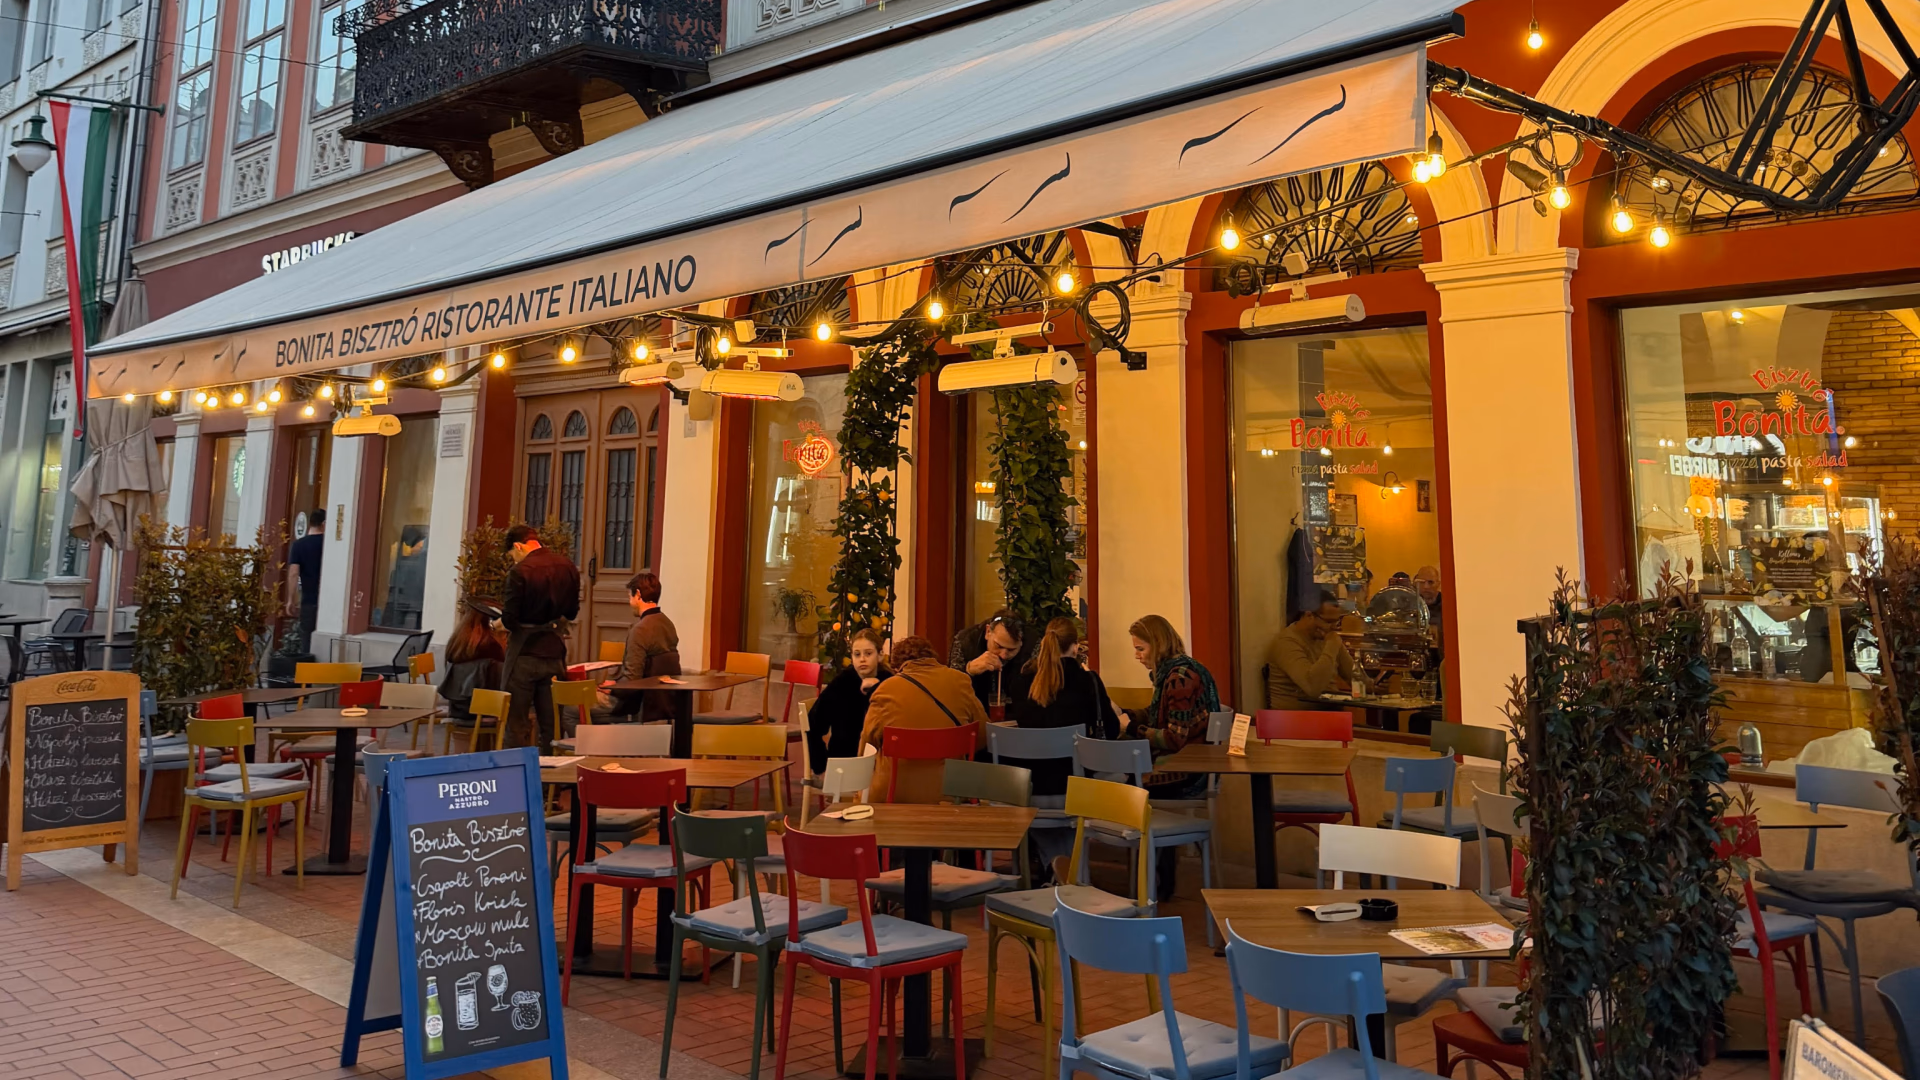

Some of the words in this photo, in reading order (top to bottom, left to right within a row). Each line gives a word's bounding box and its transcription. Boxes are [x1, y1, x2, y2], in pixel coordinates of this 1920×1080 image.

[275, 331, 334, 368] BONITA
[338, 307, 419, 357] BISZTRÓ
[421, 283, 564, 342] RISTORANTE
[568, 254, 697, 315] ITALIANO
[1752, 365, 1834, 402] Bisztró
[1289, 417, 1370, 449] Bonita
[1712, 400, 1835, 437] Bonita
[1320, 463, 1348, 478] pasta
[1349, 460, 1378, 475] salad
[1761, 453, 1803, 473] pasta
[1806, 450, 1848, 468] salad
[28, 706, 80, 727] Bonita
[438, 780, 497, 799] PERONI
[448, 800, 490, 810] AZZURRO
[454, 795, 482, 803] NASTRO
[409, 827, 466, 853] Bonita
[467, 816, 527, 845] Bisztró
[417, 871, 473, 900] Csapolt
[475, 865, 527, 887] Peroni
[416, 900, 465, 923] Floris
[474, 890, 527, 913] Kriek
[421, 922, 486, 945] Moscow
[491, 910, 530, 933] mule
[421, 940, 480, 968] Bonita
